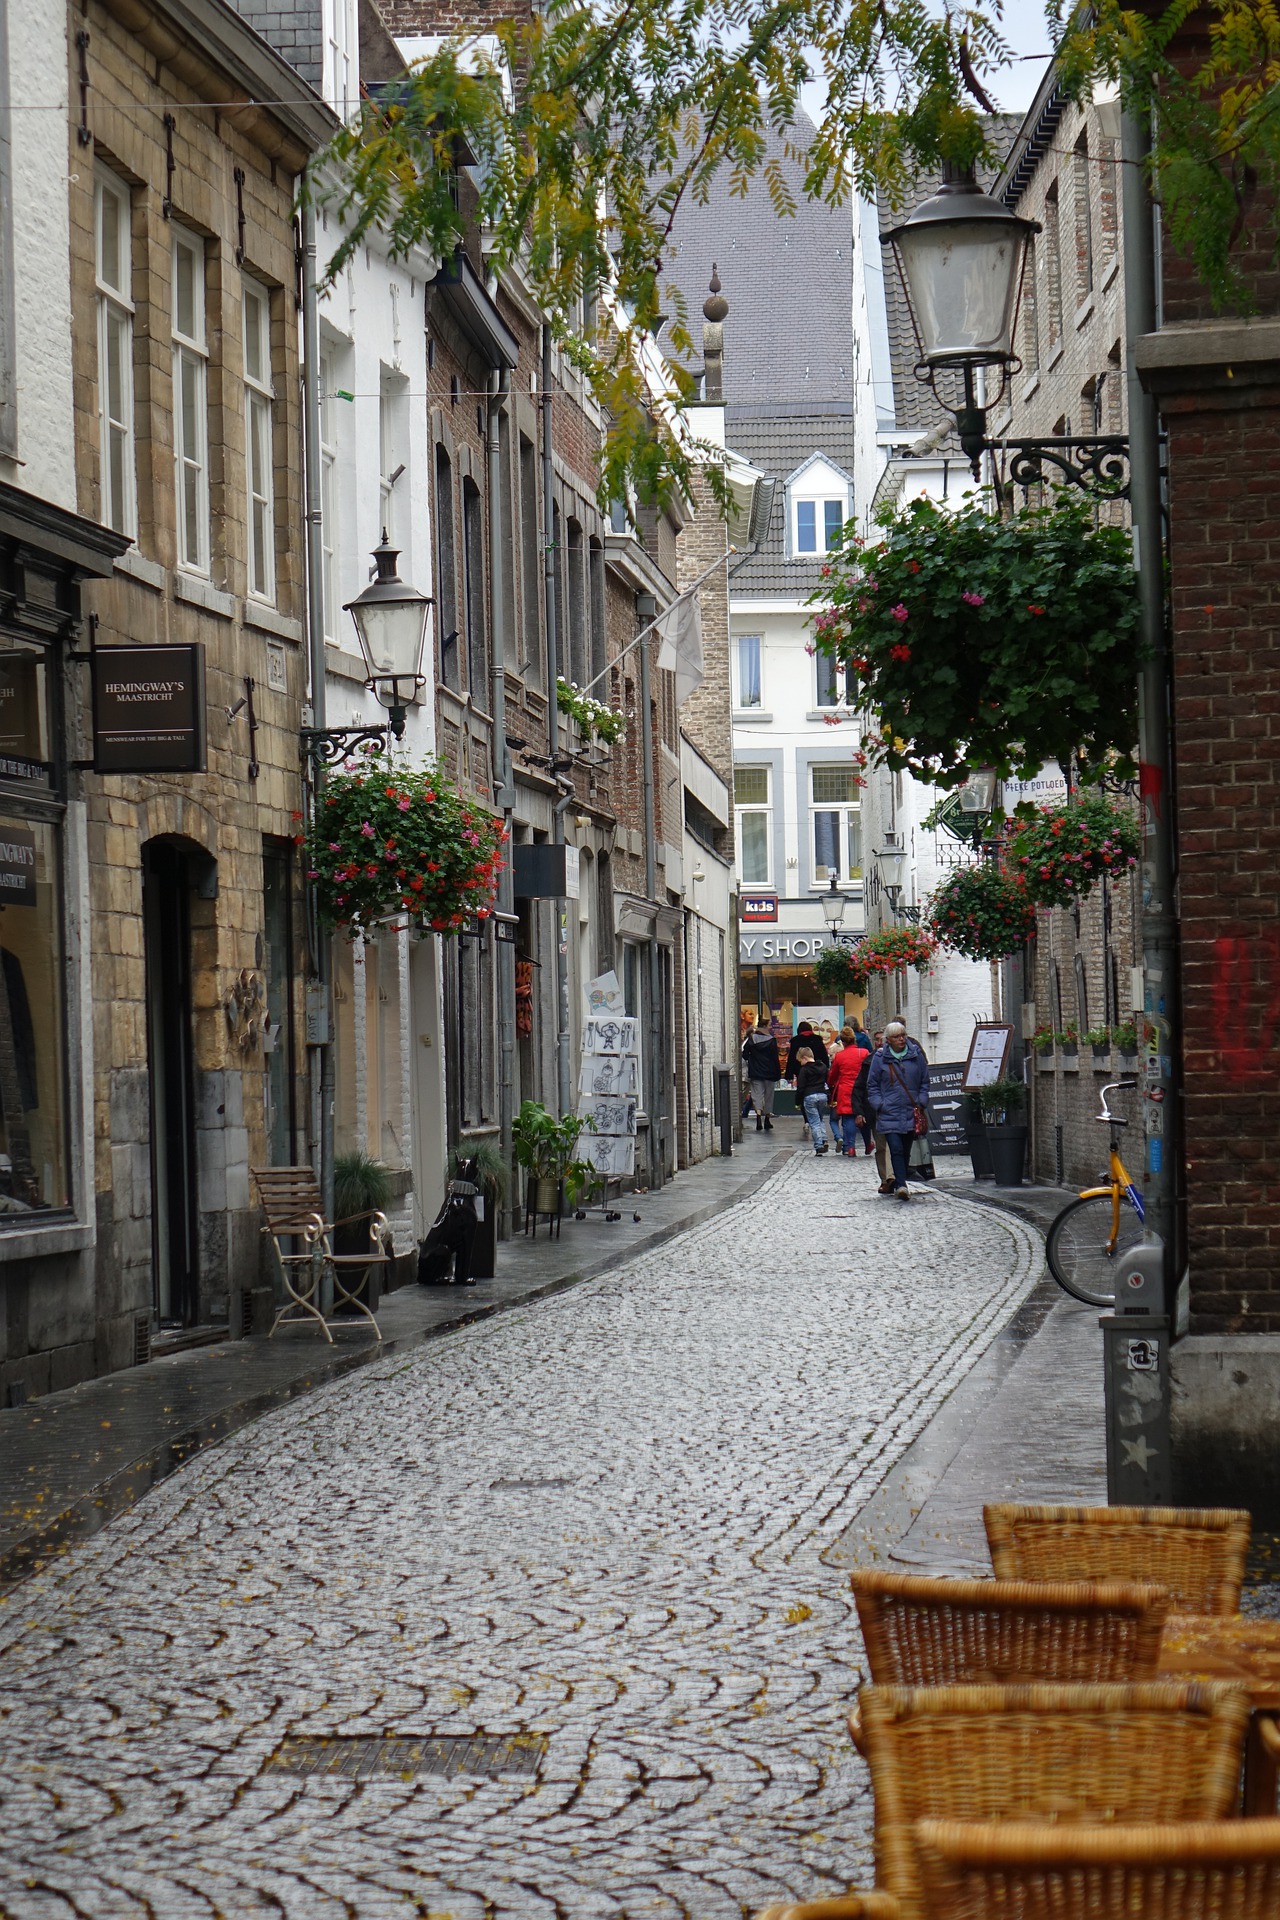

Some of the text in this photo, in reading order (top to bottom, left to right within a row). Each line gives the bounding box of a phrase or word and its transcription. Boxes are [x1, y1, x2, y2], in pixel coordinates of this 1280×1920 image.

[105, 681, 185, 693] HEMINGWAY'S
[116, 692, 174, 702] MAASTRICHT
[1031, 779, 1065, 790] POTLOED
[745, 901, 774, 912] kids
[763, 938, 824, 958] SHOP
